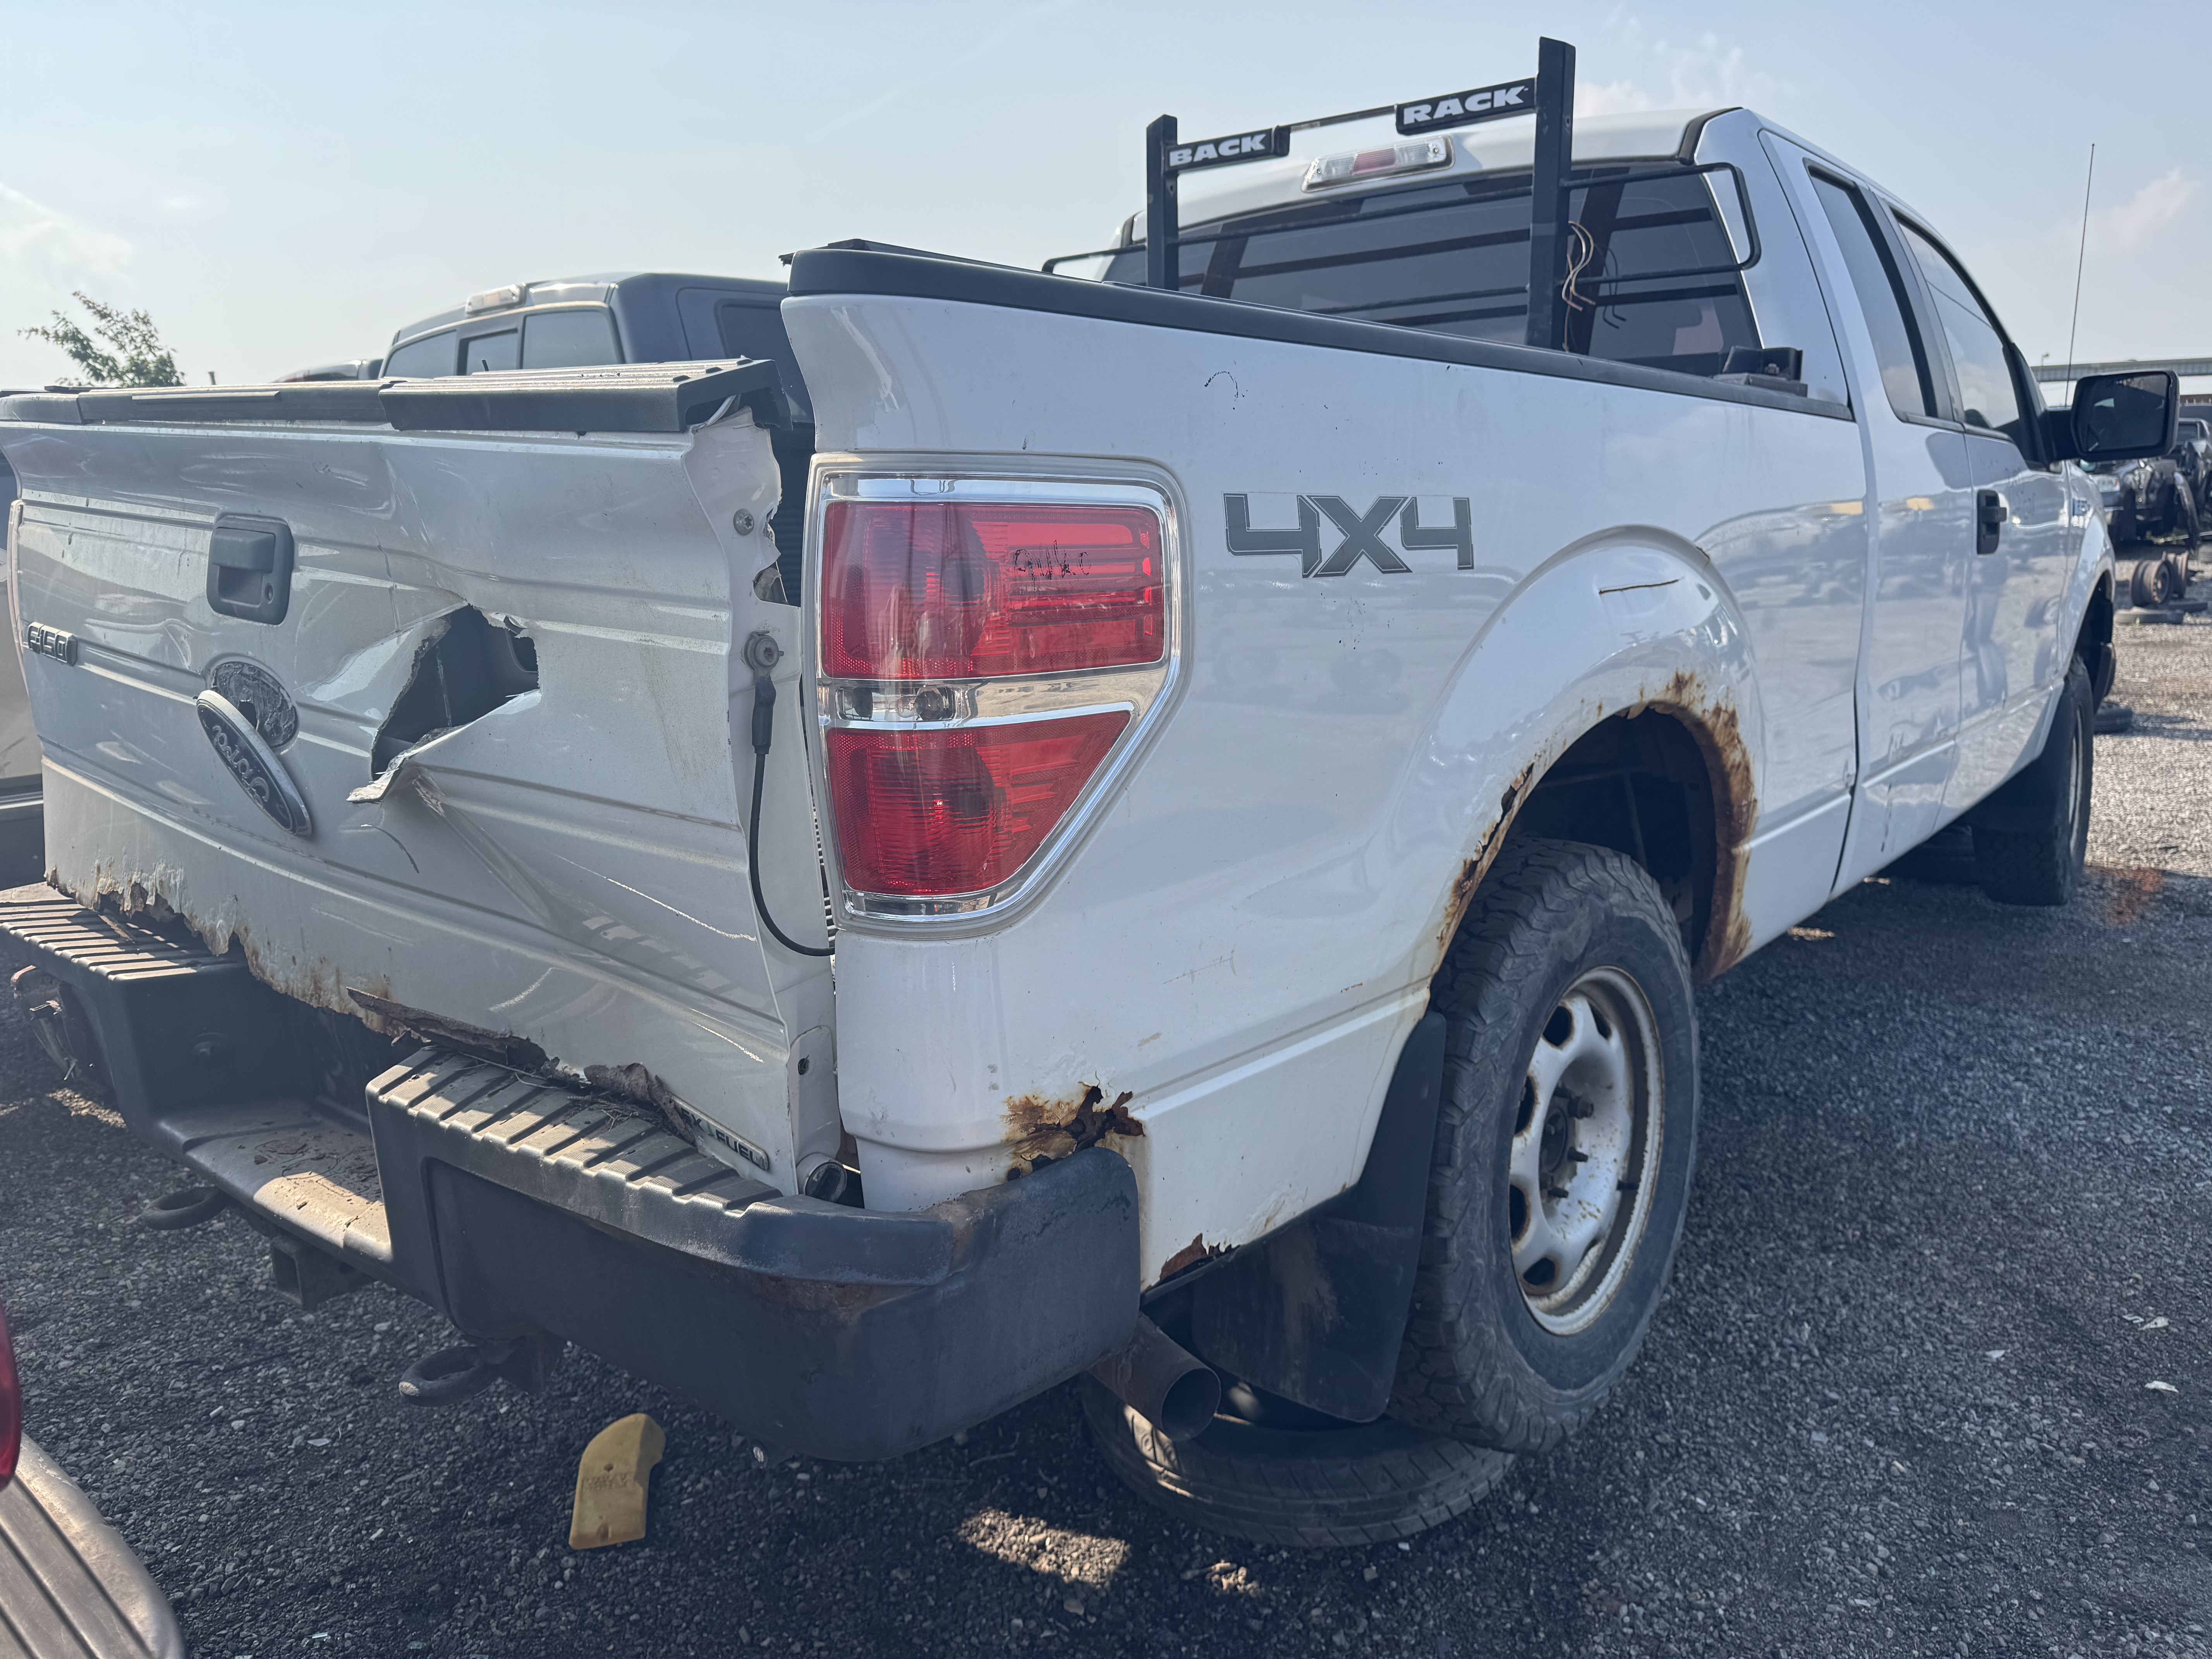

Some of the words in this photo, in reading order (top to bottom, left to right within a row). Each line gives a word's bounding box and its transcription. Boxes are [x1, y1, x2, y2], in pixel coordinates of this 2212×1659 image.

[1170, 134, 1266, 167] BACK
[1403, 85, 1526, 125] RACK
[1223, 493, 1474, 578] 4X4
[212, 725, 270, 810] Ford
[715, 1128, 763, 1169] FUEL
